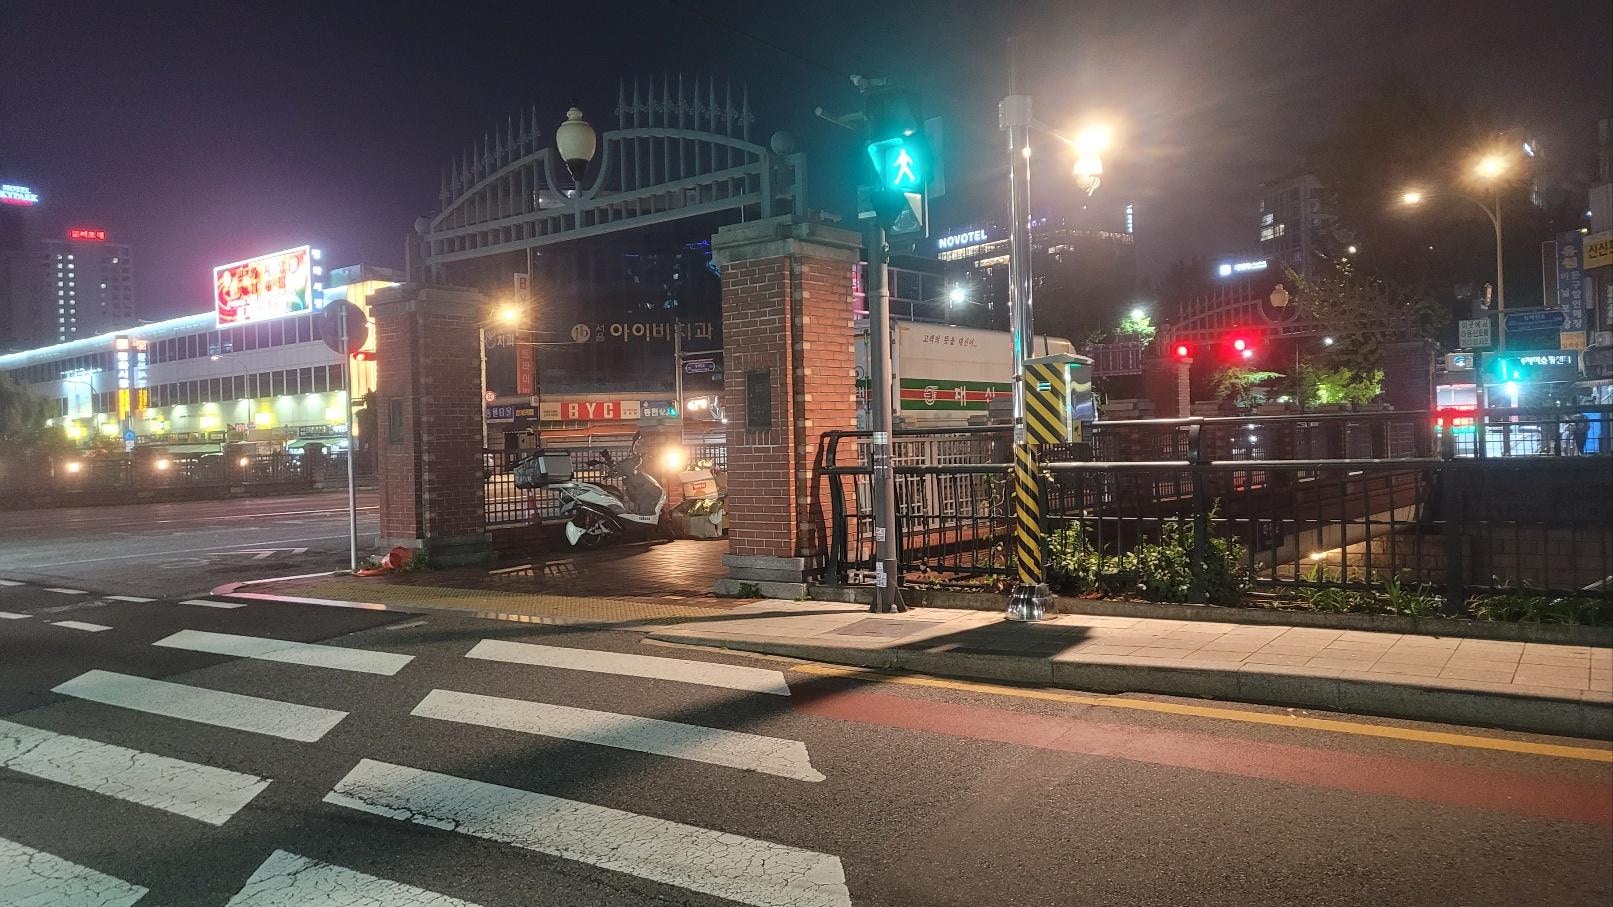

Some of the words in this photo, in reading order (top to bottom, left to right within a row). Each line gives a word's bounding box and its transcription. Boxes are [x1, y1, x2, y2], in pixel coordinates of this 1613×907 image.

[939, 229, 988, 249] NOVOTEL
[923, 334, 940, 344] 고객의
[568, 402, 614, 419] BYC
